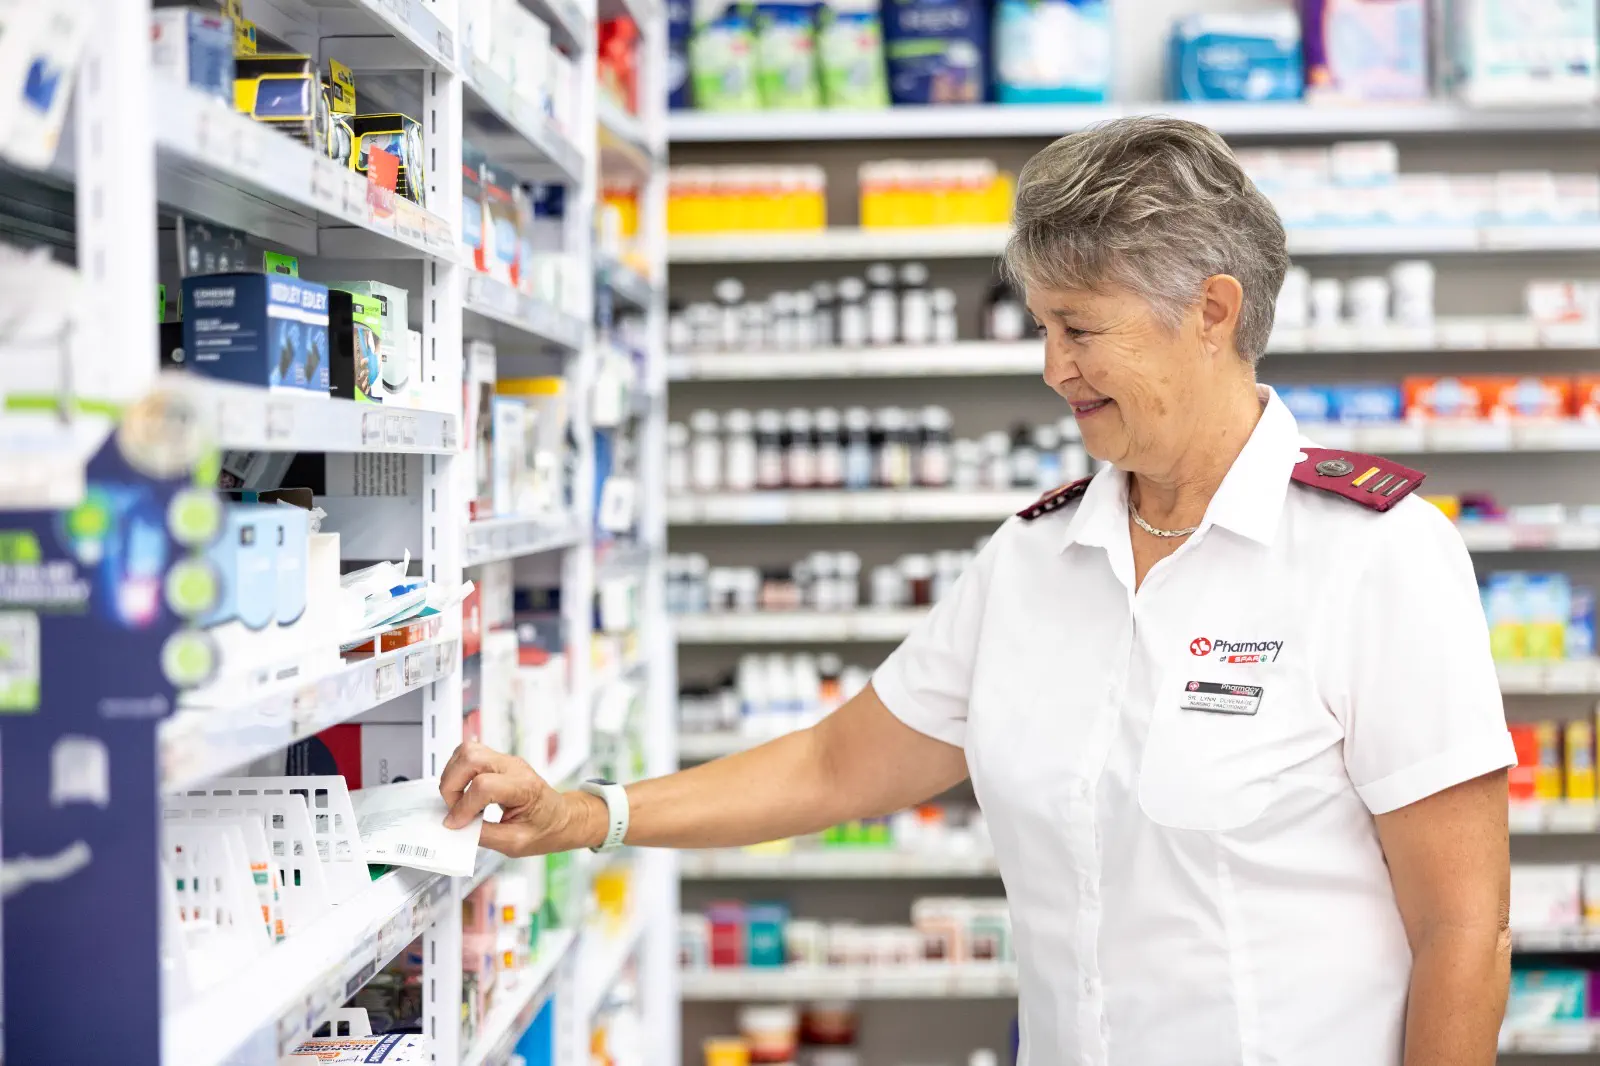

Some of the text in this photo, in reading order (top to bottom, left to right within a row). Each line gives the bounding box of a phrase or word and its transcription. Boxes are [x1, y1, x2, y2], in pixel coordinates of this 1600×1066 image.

[1213, 640, 1284, 662] Pharmacy
[1234, 655, 1260, 663] SPAR
[1220, 684, 1260, 696] Pharmacy
